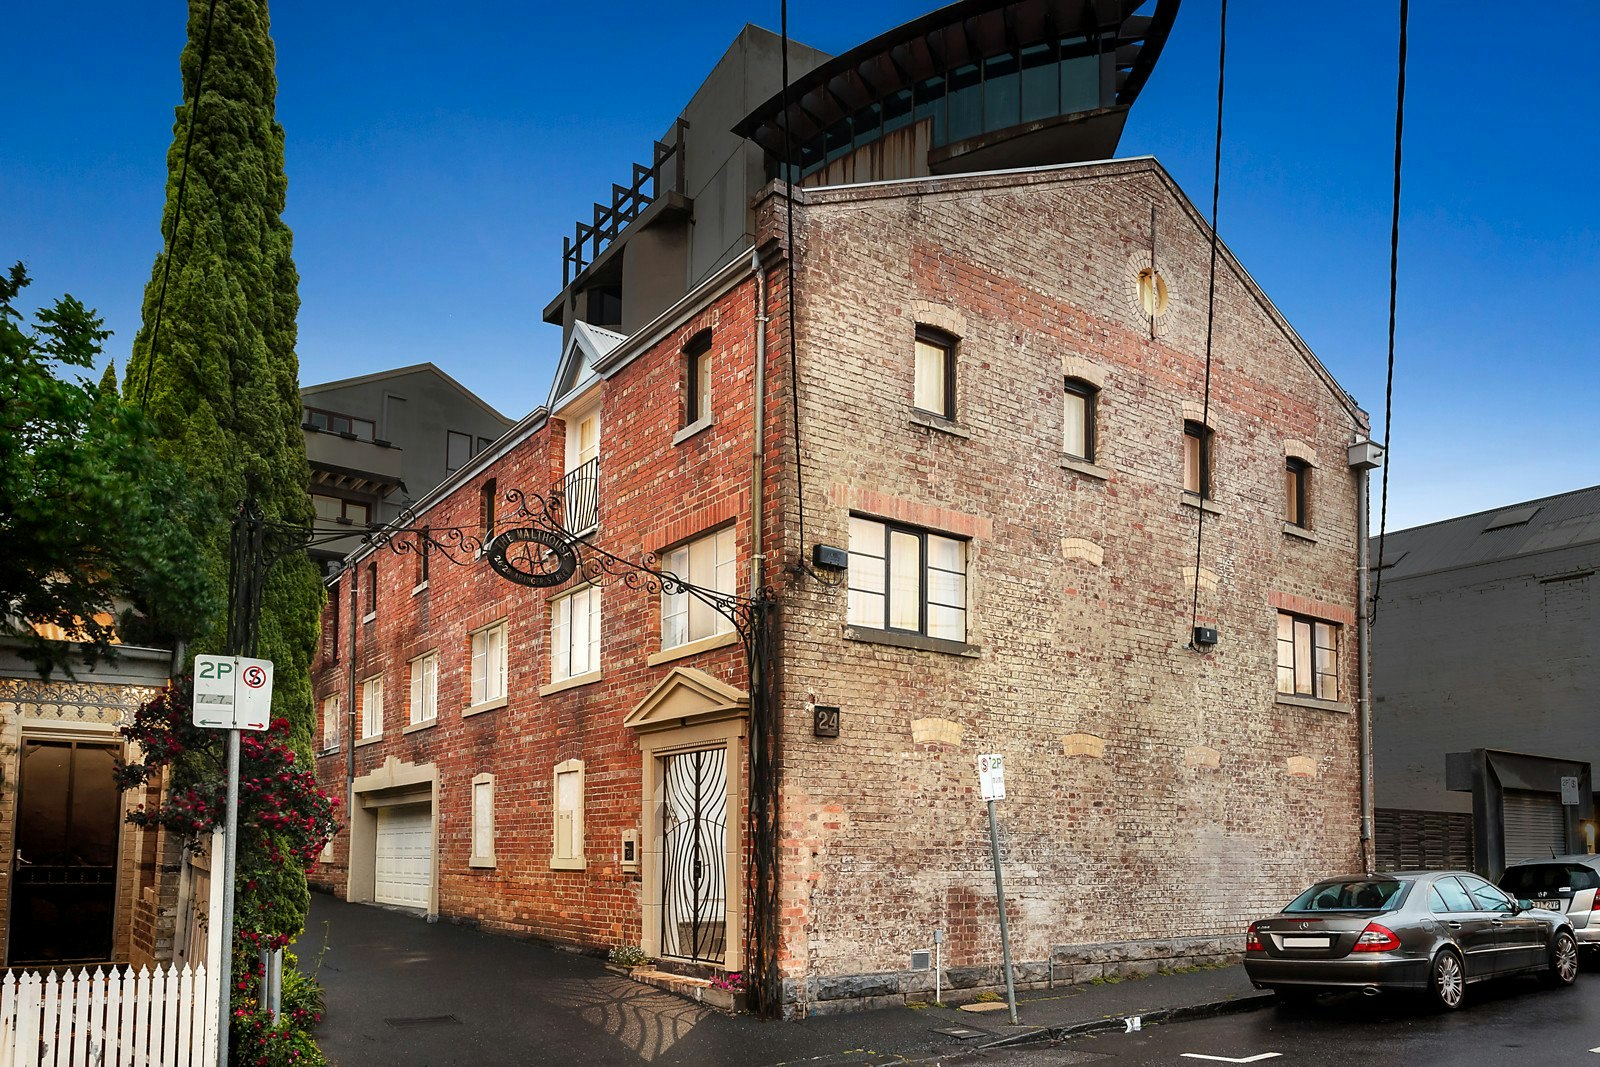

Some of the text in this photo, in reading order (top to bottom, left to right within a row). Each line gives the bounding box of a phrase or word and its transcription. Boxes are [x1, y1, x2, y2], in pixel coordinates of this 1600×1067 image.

[496, 529, 573, 560] THE MALTHOUSE
[199, 661, 233, 679] 2P
[818, 711, 838, 730] 24
[992, 758, 1002, 769] 2P
